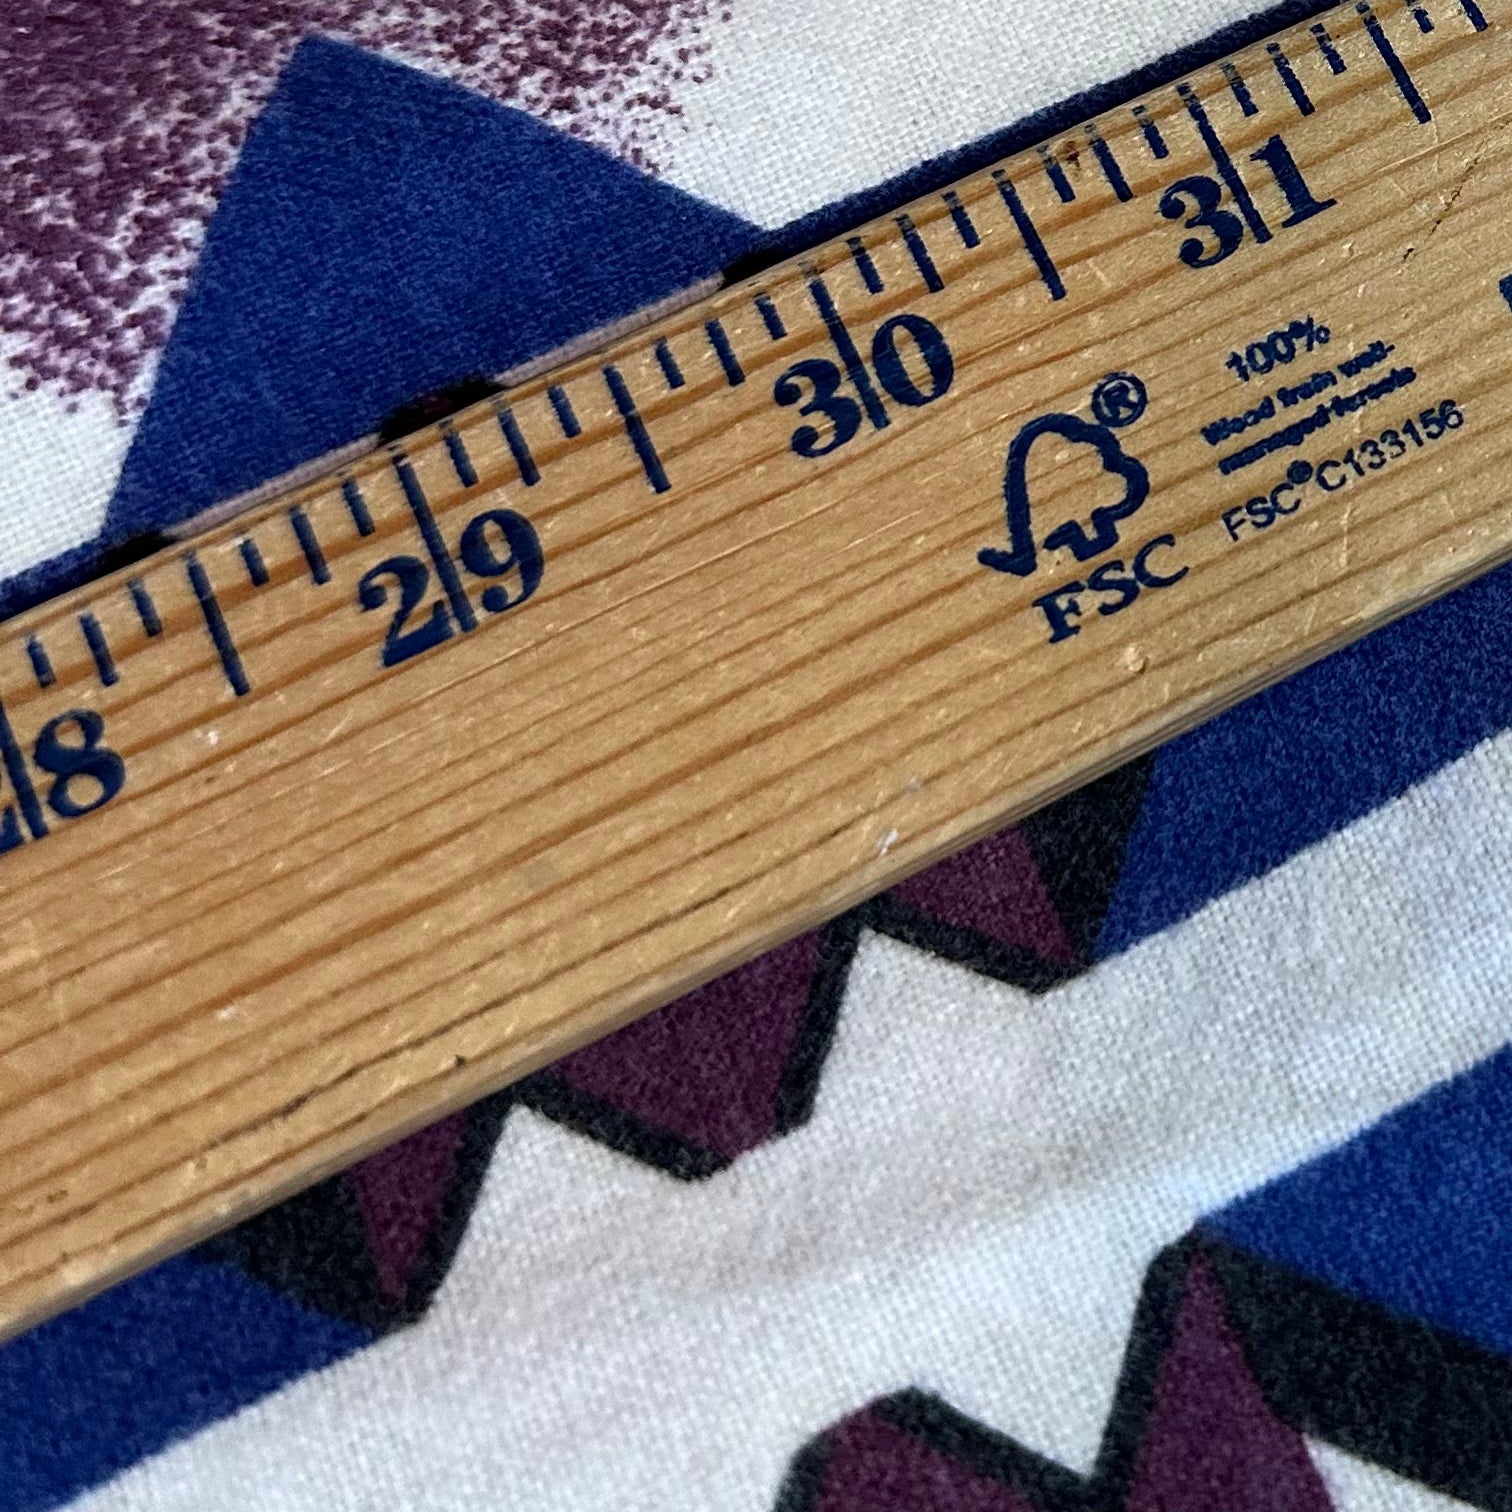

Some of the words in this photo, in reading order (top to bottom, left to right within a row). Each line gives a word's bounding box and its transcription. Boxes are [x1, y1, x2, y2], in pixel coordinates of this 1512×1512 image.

[1158, 134, 1338, 269] 31
[773, 313, 956, 458] 30
[1225, 314, 1330, 382] 100%
[358, 508, 545, 668] 29
[1031, 533, 1190, 644] FSC
